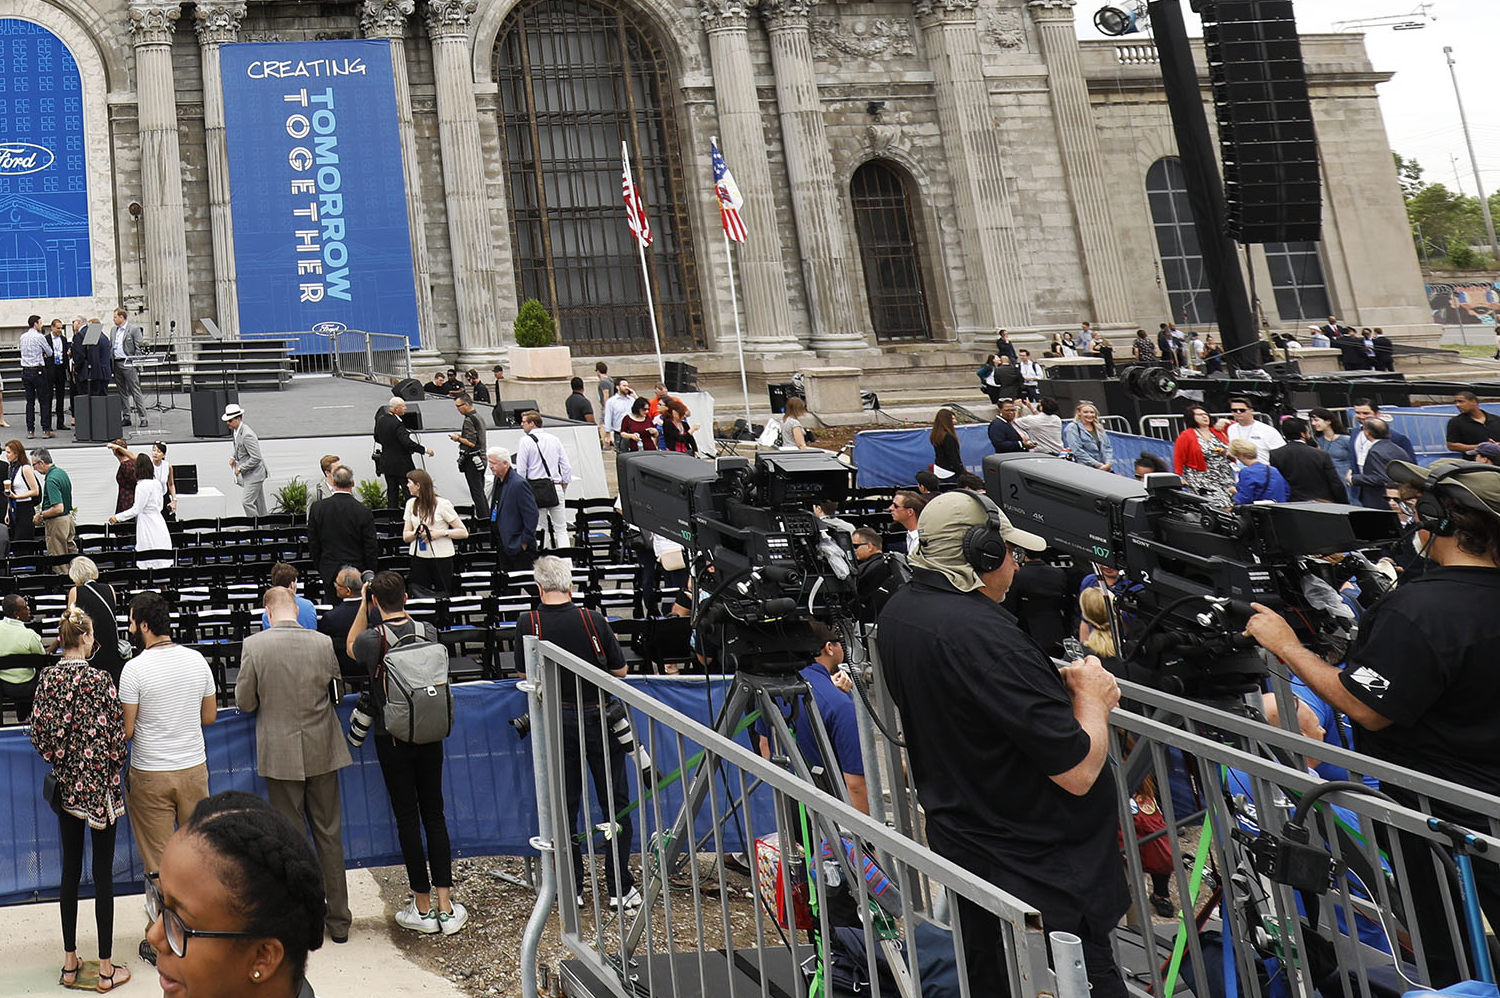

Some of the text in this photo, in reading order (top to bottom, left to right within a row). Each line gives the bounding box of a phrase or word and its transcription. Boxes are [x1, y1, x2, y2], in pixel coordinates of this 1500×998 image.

[247, 58, 367, 79] CREATING
[283, 88, 325, 303] TOGETHER
[310, 87, 352, 302] TOMORROW
[1009, 483, 1019, 500] 2
[1032, 512, 1045, 521] 4K
[681, 529, 692, 541] 107
[1132, 538, 1150, 549] SONY
[1092, 545, 1110, 558] 107
[1140, 570, 1151, 584] 2
